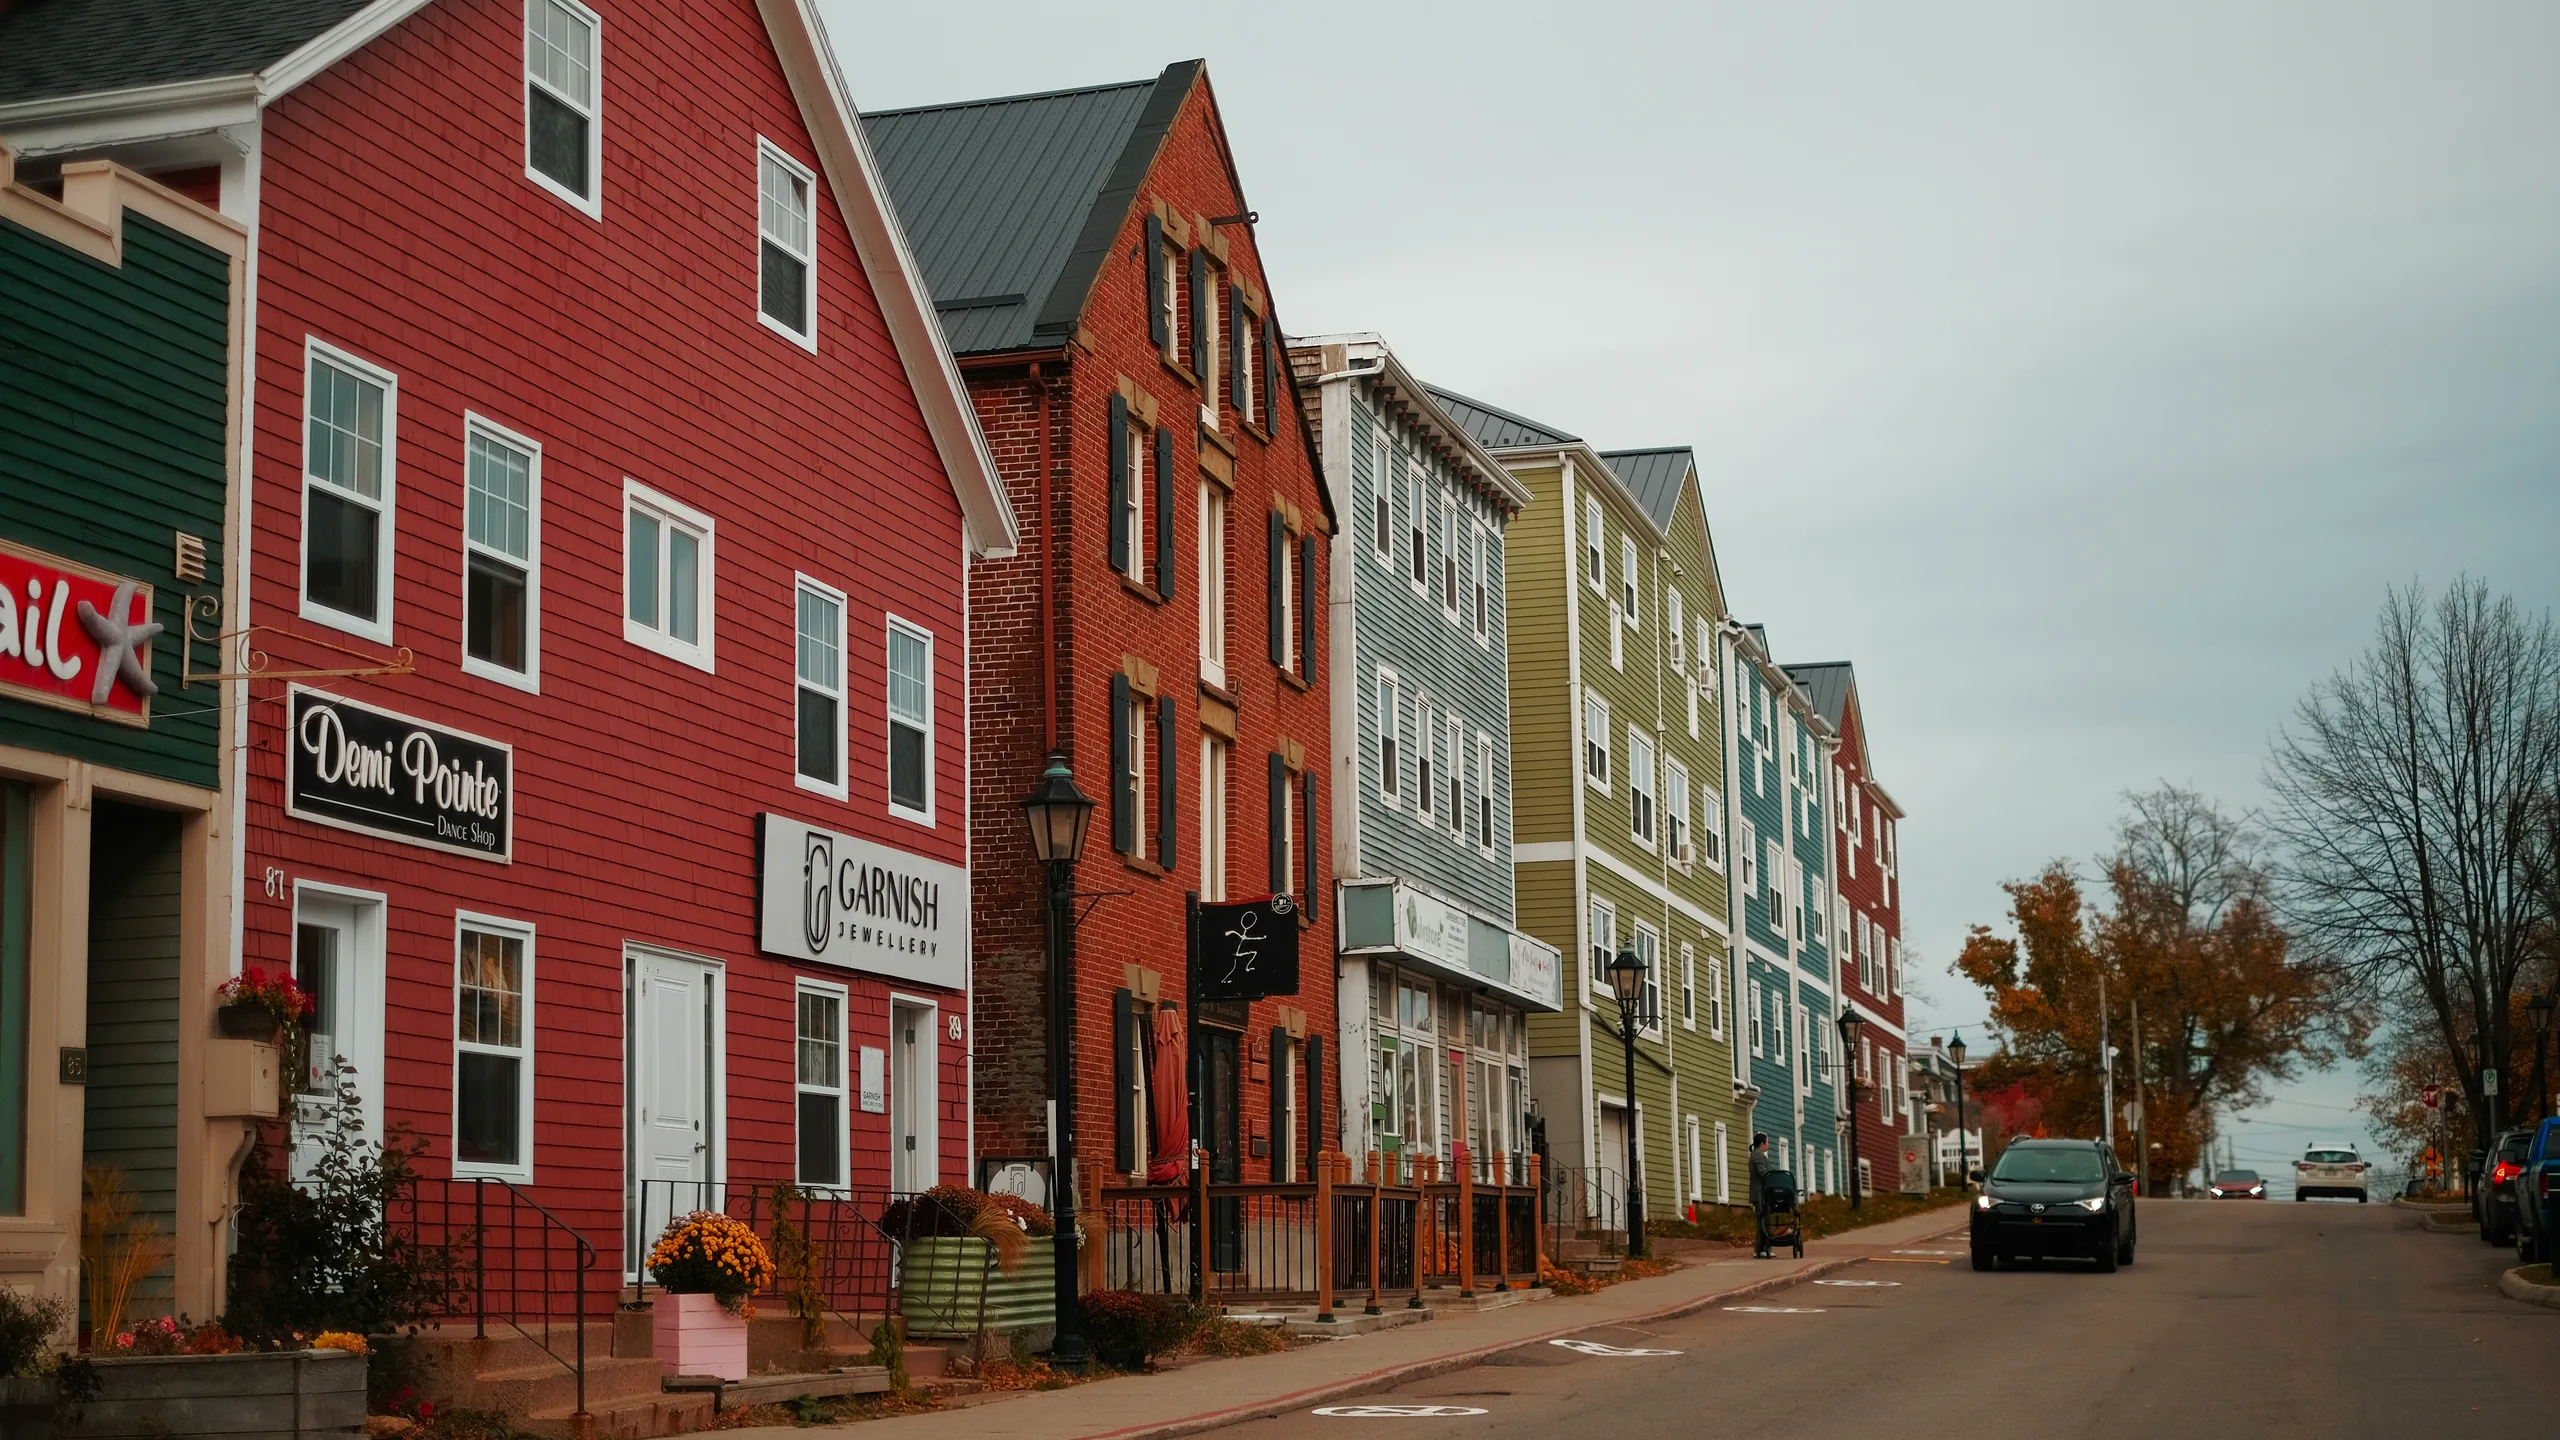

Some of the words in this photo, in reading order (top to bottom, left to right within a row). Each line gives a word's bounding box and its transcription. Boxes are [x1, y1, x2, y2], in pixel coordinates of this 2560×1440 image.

[301, 705, 395, 796] Demi
[401, 731, 499, 820] Pointe
[265, 866, 285, 900] 87
[838, 858, 938, 931] GARNISH
[838, 921, 937, 958] JEWELLERY
[948, 1015, 962, 1040] 89
[68, 1056, 82, 1075] 85
